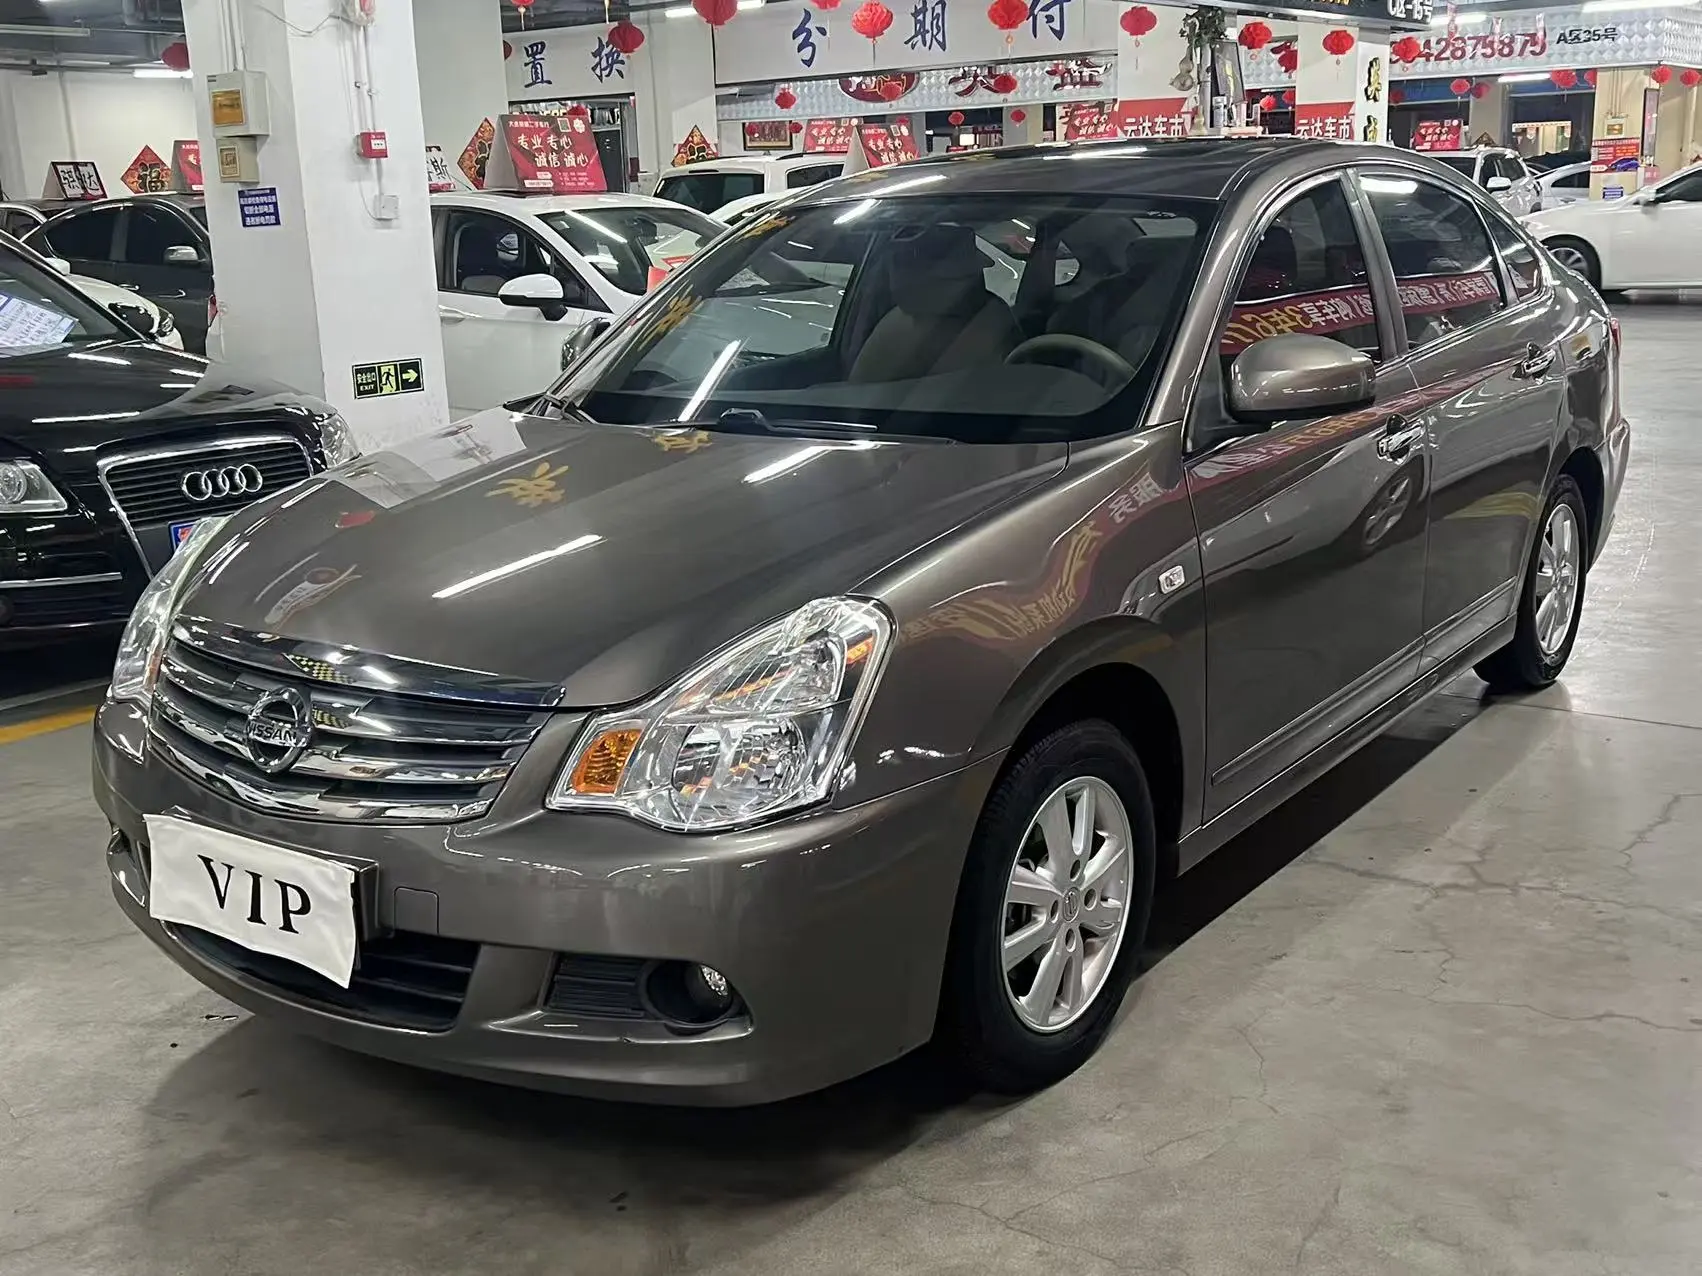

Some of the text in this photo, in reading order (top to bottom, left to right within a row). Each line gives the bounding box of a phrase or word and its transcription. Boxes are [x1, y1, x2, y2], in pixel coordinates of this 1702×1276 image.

[524, 36, 626, 88] 置换
[1124, 114, 1184, 137] 云达车市
[1296, 115, 1351, 139] 云达车市
[517, 133, 573, 150] 专业 专心
[534, 151, 589, 168] 诚信 诚心
[360, 384, 375, 392] EXIT
[197, 854, 312, 934] VIP
